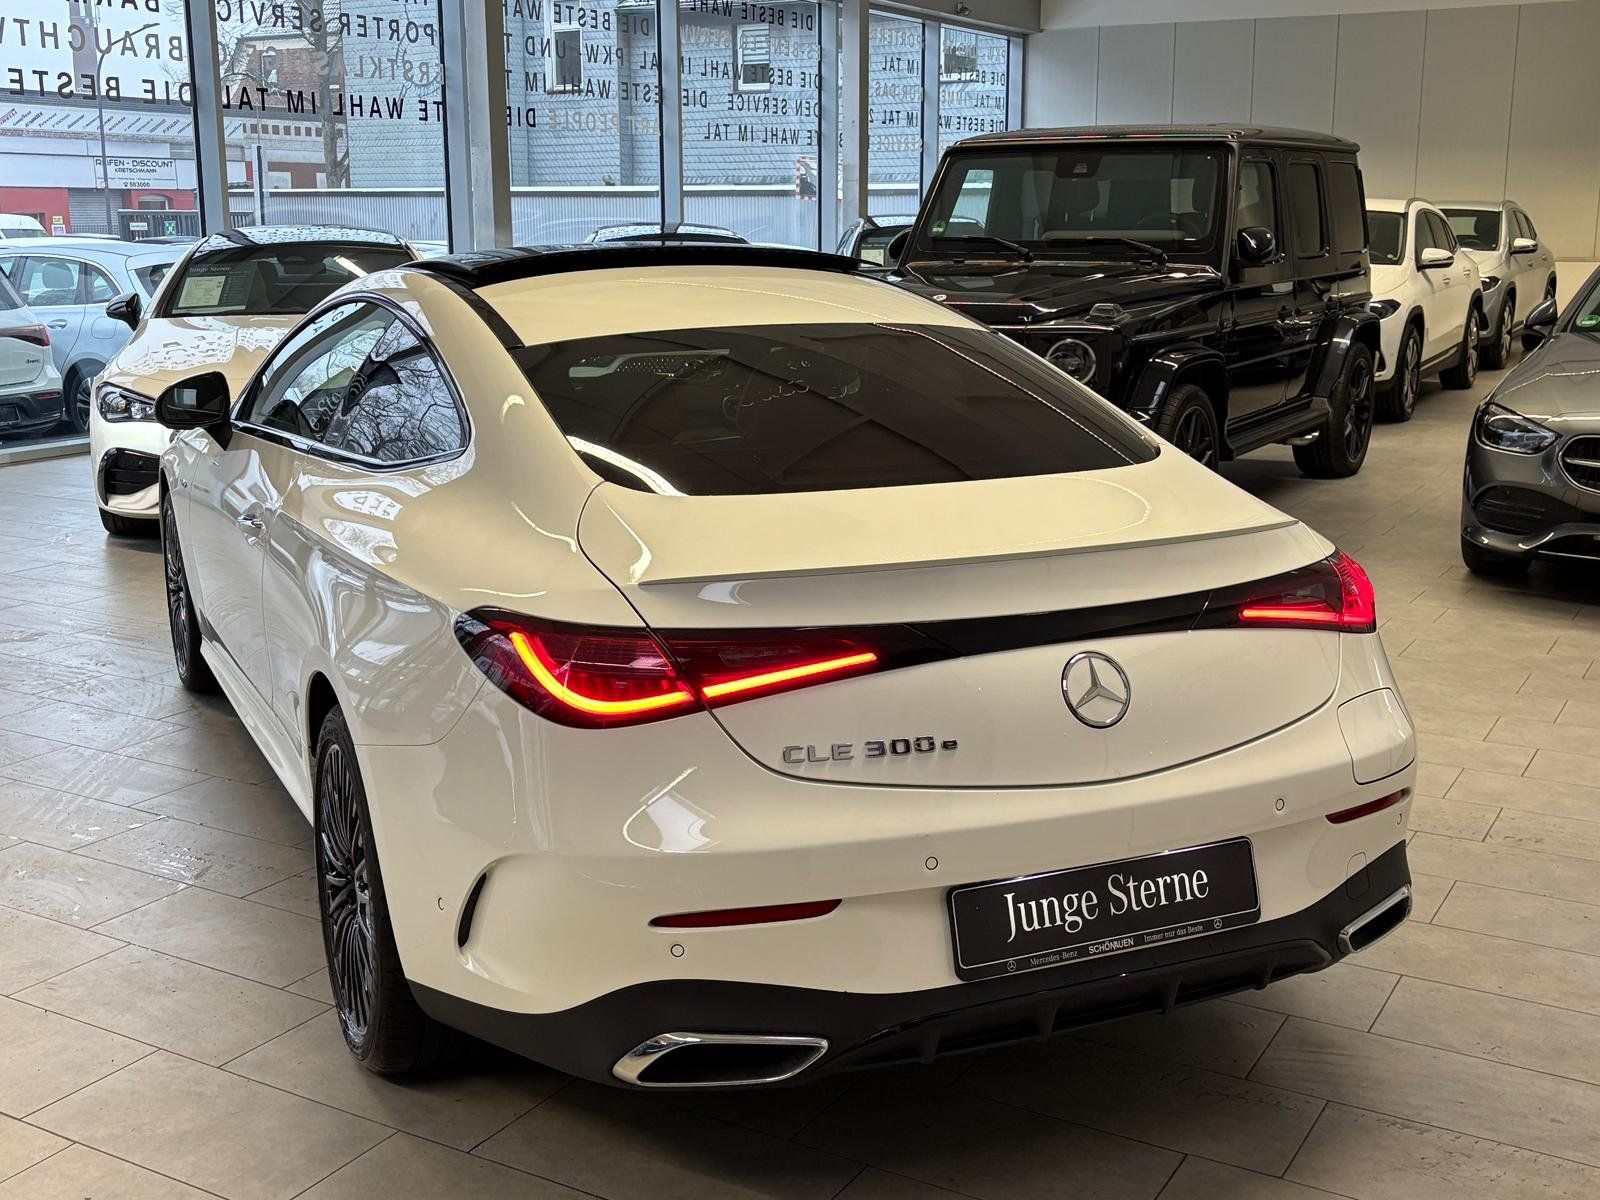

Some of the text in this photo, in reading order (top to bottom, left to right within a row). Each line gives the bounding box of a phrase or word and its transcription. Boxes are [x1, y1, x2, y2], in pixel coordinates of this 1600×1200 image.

[131, 160, 174, 168] DISCOUNT
[782, 743, 855, 764] CLE
[1003, 868, 1210, 943] Junge Sterne
[1030, 950, 1079, 967] Mercedes-Benz
[1143, 932, 1164, 943] Immer
